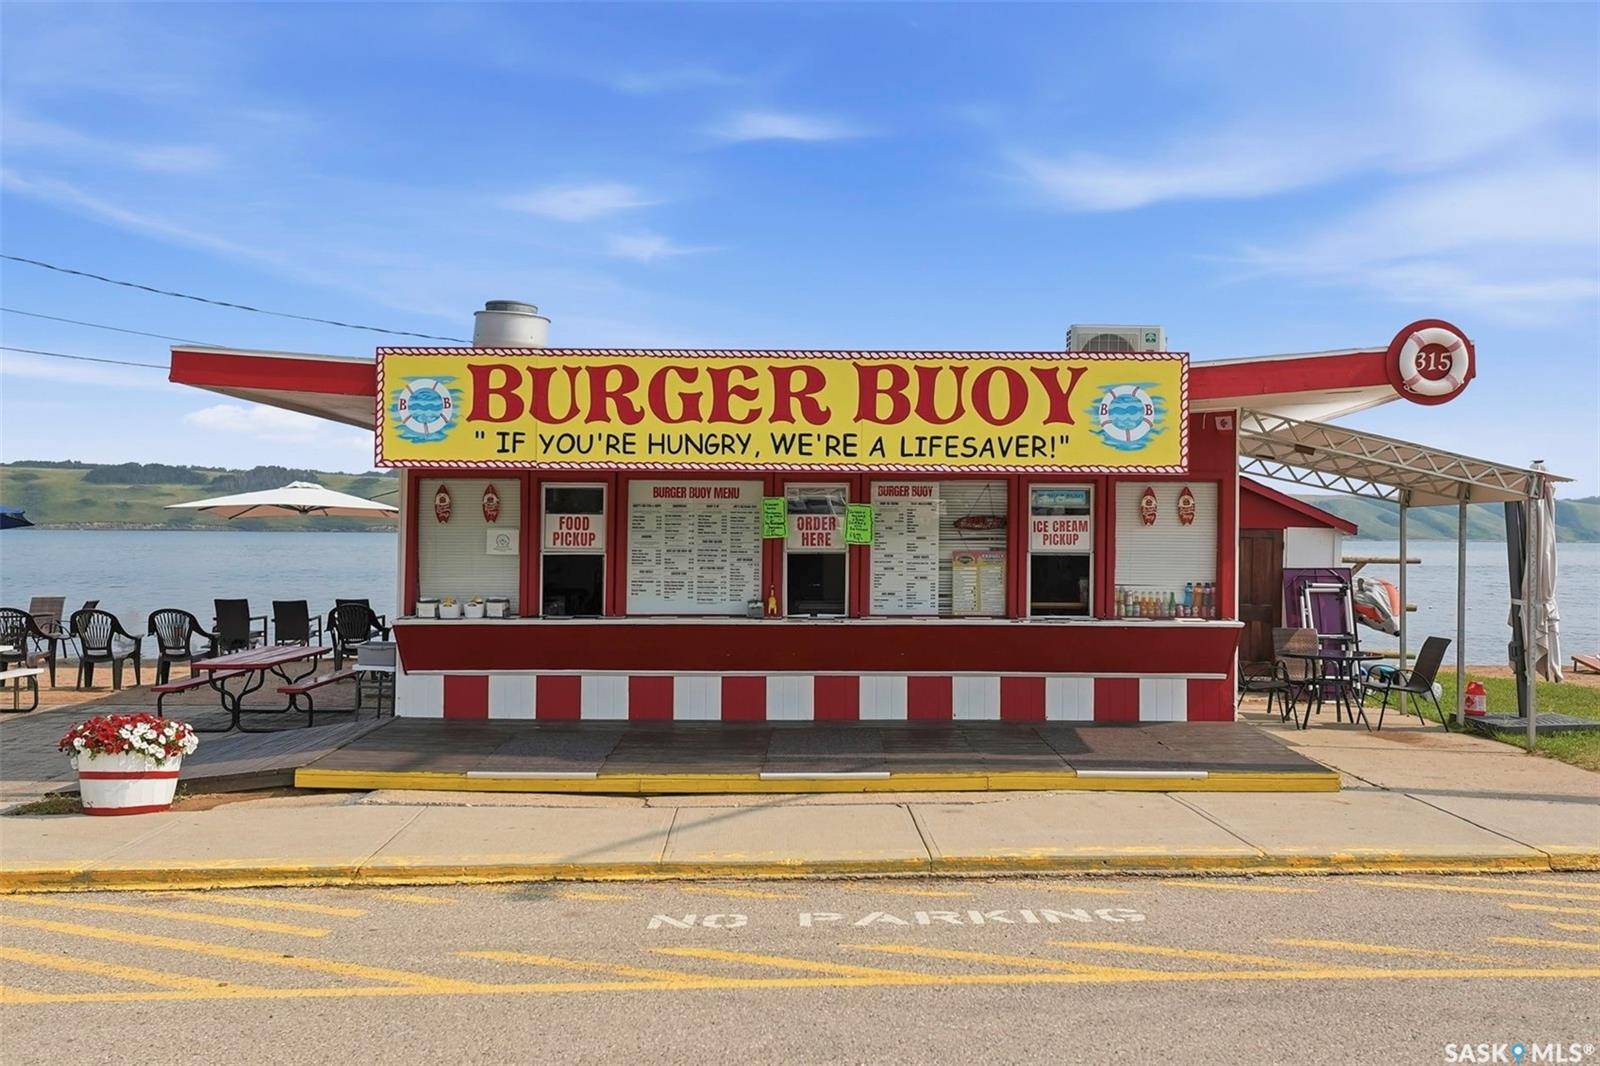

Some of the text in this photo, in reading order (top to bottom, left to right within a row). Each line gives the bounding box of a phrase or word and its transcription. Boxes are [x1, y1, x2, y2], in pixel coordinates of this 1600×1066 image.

[1416, 352, 1451, 371] 315
[465, 361, 1088, 427] BURGER BUOY
[400, 397, 452, 410] B B
[1100, 403, 1153, 416] B B
[538, 433, 637, 455] YOU'RE
[648, 433, 761, 458] HUNGRY,
[771, 433, 858, 457] WE'RE
[869, 436, 887, 458] A
[900, 435, 1069, 459] LIFESAVER!"
[652, 486, 740, 499] BURGER BUOY MENU
[878, 485, 934, 497] BURGER BUOY
[559, 516, 590, 531] FOOD
[797, 516, 836, 531] ORDER
[1033, 520, 1089, 533] ICE CREAM
[552, 531, 596, 547] PICKUP
[801, 532, 832, 547] HERE
[1042, 533, 1079, 546] PICKUP
[646, 907, 1147, 930] NO PARKING
